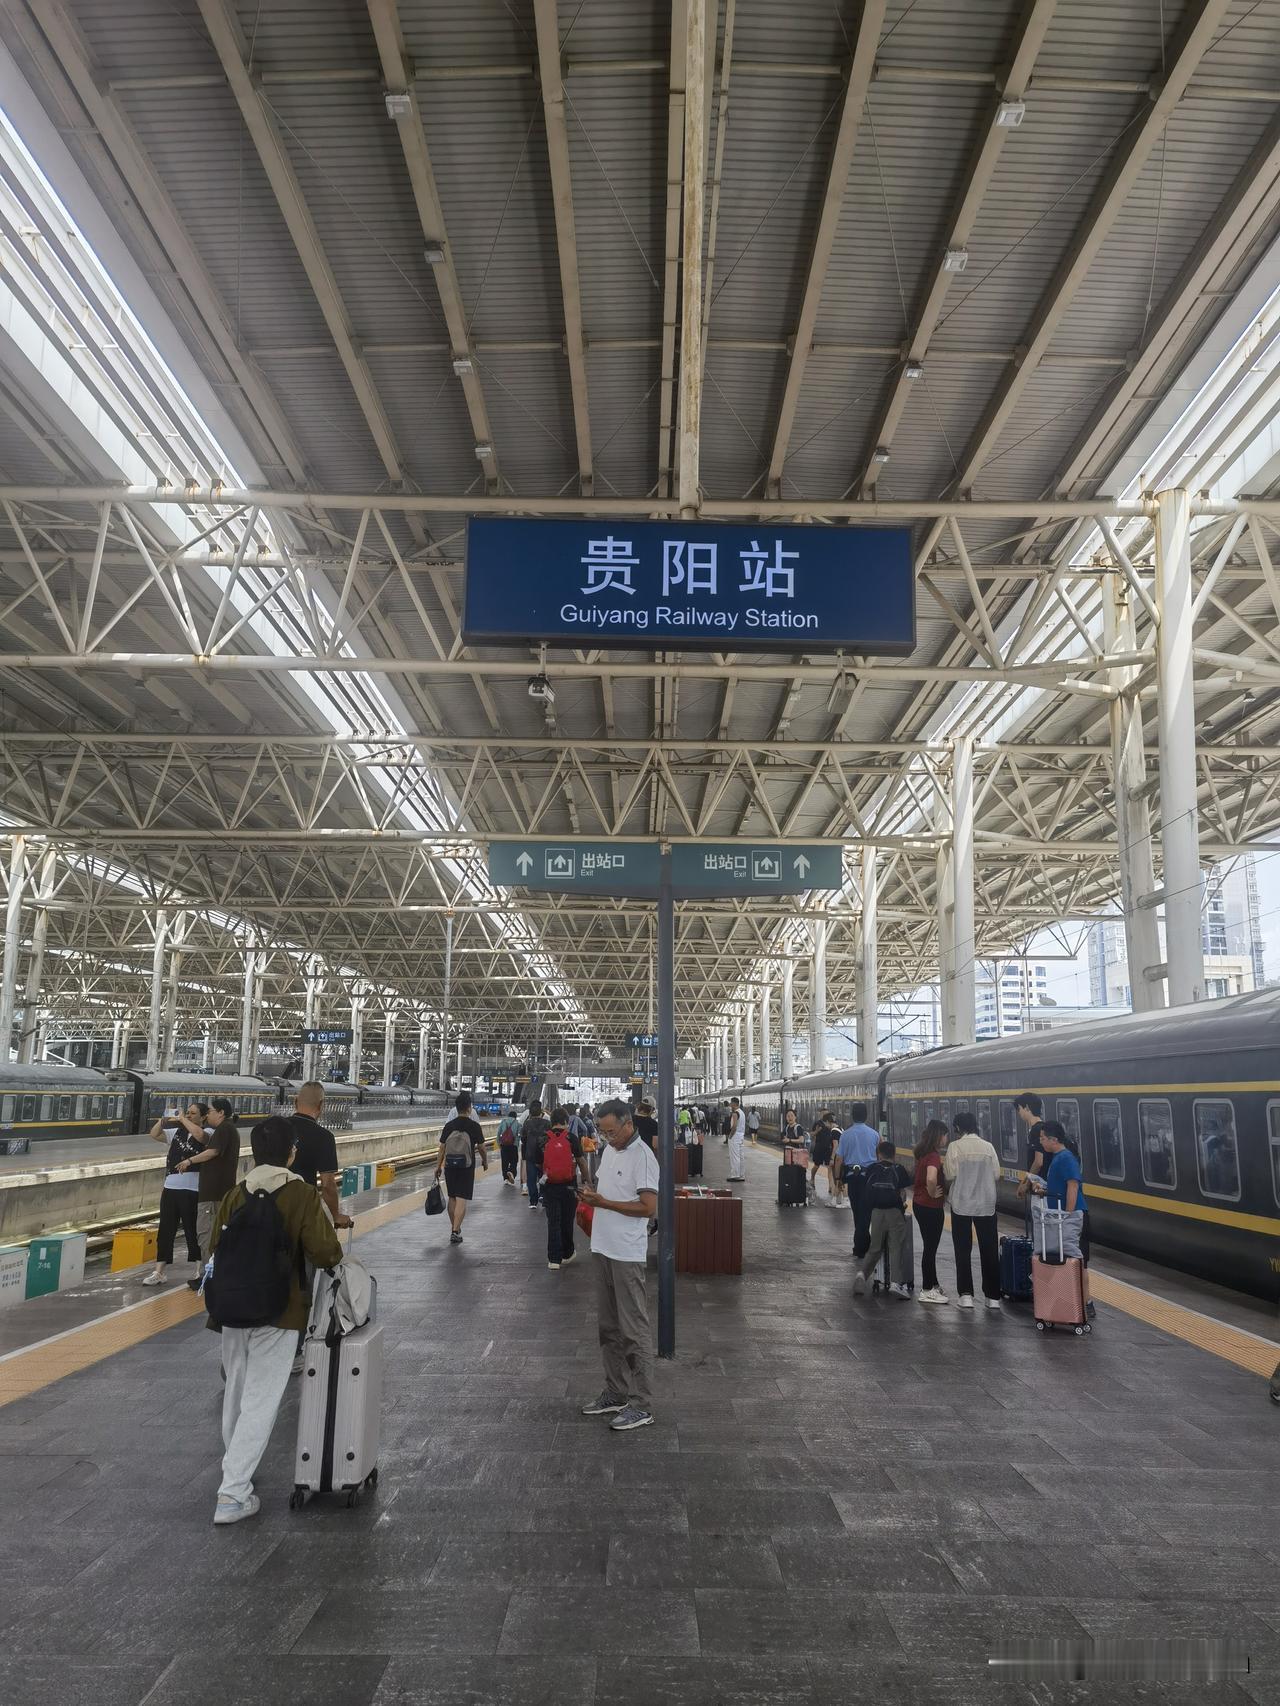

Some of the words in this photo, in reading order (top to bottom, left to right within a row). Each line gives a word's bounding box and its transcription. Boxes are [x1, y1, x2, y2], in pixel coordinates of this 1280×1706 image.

[580, 536, 800, 598] 贵阳站
[560, 604, 649, 629] Guiyang
[655, 606, 740, 630] Railway
[745, 608, 819, 629] Station
[582, 852, 625, 869] 出站口
[704, 854, 747, 870] 出站口
[580, 869, 594, 877] Exit
[733, 870, 747, 878] Exit
